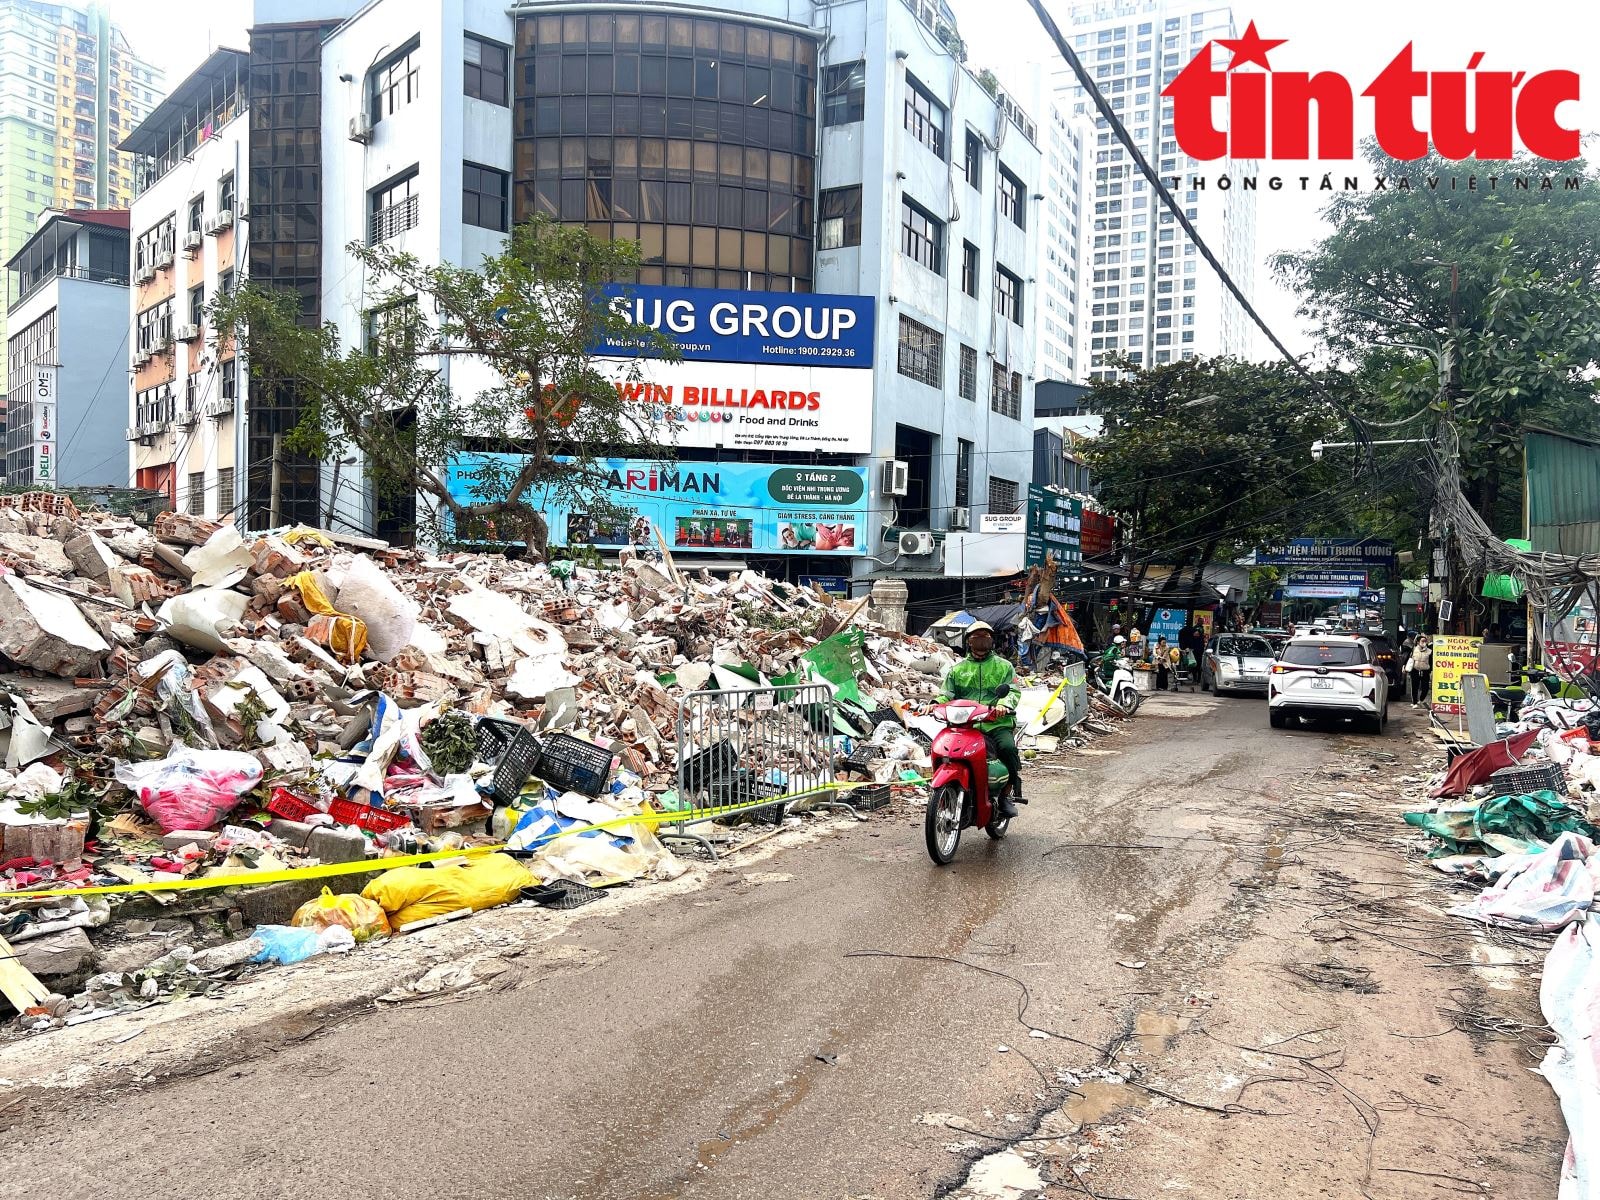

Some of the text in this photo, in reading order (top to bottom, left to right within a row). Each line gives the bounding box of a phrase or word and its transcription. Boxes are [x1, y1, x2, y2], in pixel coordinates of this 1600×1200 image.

[608, 296, 856, 341] SUG GROUP
[762, 345, 797, 355] Hotline:
[798, 346, 855, 357] 1900.2929.36
[682, 386, 821, 411] BILLIARDS
[739, 415, 765, 425] Food
[788, 418, 819, 427] Drinks
[831, 474, 836, 482] 2
[1330, 546, 1361, 556] TRUNG
[1434, 704, 1452, 712] 25K
